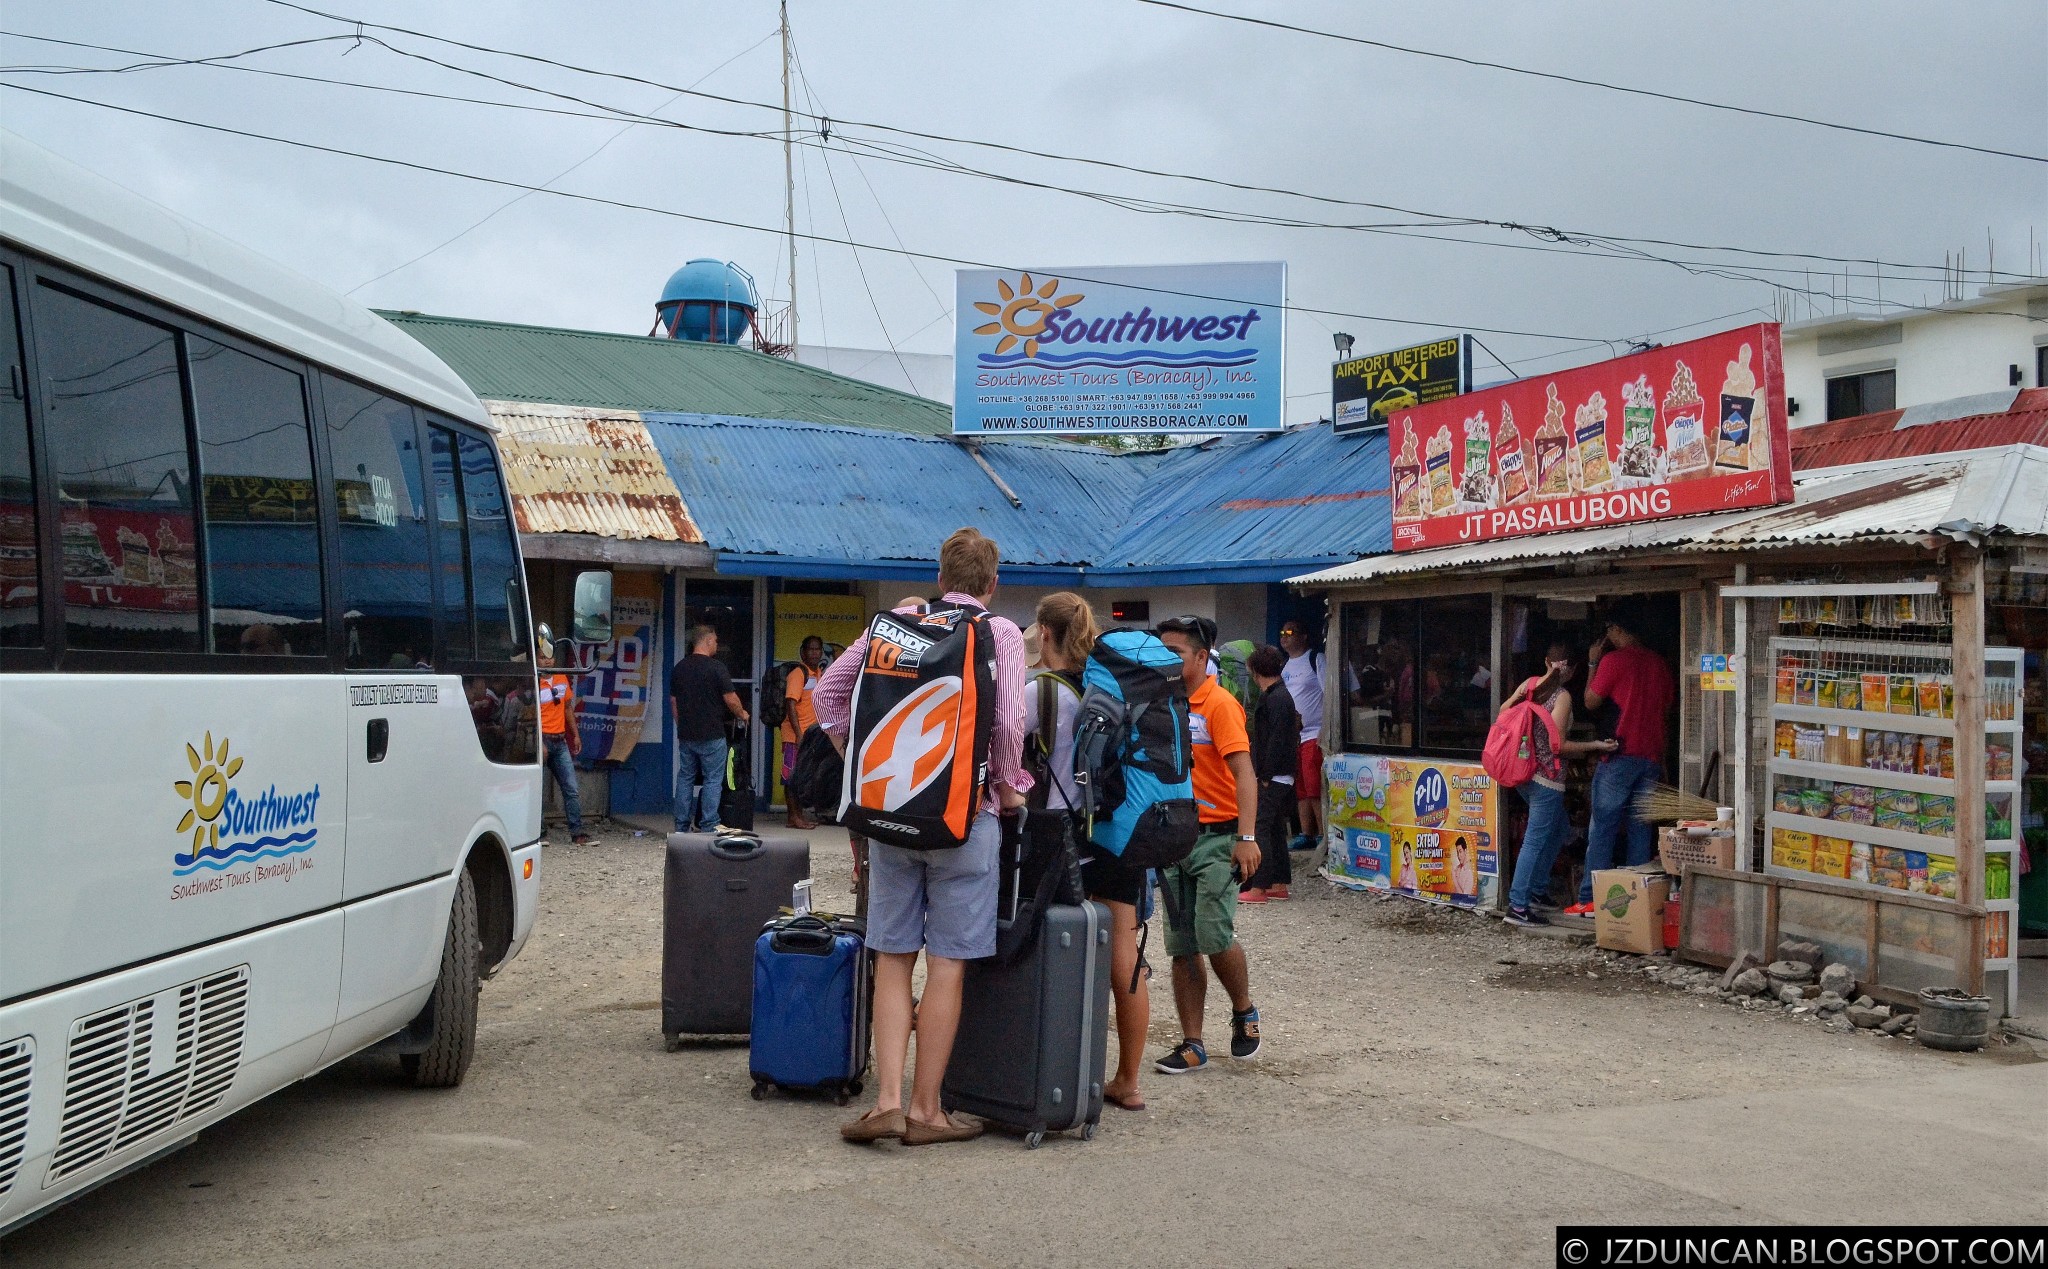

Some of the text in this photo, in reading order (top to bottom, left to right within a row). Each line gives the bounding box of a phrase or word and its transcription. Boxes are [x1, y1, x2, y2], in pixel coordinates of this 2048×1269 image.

[1036, 306, 1261, 345] Southwest
[1336, 340, 1457, 379] AIRPORT METERED
[975, 367, 1258, 391] Southwest Tours (Boracay), Inc.
[1361, 361, 1427, 391] TAXI
[978, 396, 1016, 404] HOTLINE:
[1051, 394, 1070, 402] 5100
[1076, 394, 1108, 402] SMART:
[1126, 393, 1141, 401] 947
[1202, 392, 1217, 400] 999
[1025, 404, 1057, 412] GLOBE:
[1108, 403, 1126, 411] 1901
[1167, 402, 1181, 410] 568
[981, 414, 1249, 430] WWW.SOUTHWESTTOURSBORACAY.COM
[1459, 488, 1671, 539] JT PASALUBONG
[868, 637, 902, 669] 10
[350, 684, 438, 706] TOURIST TRANSPORT SERVICE
[1473, 774, 1490, 789] CALLS
[1896, 796, 1914, 804] Piaya
[219, 784, 320, 838] Southwest
[1852, 812, 1870, 821] Piaya
[1359, 838, 1378, 849] UCT50
[1416, 832, 1439, 849] EXTEND
[1666, 836, 1712, 846] NATURE'S
[1672, 844, 1706, 853] SPRING
[171, 857, 314, 900] Southwest Tours (Boracay), Inc.
